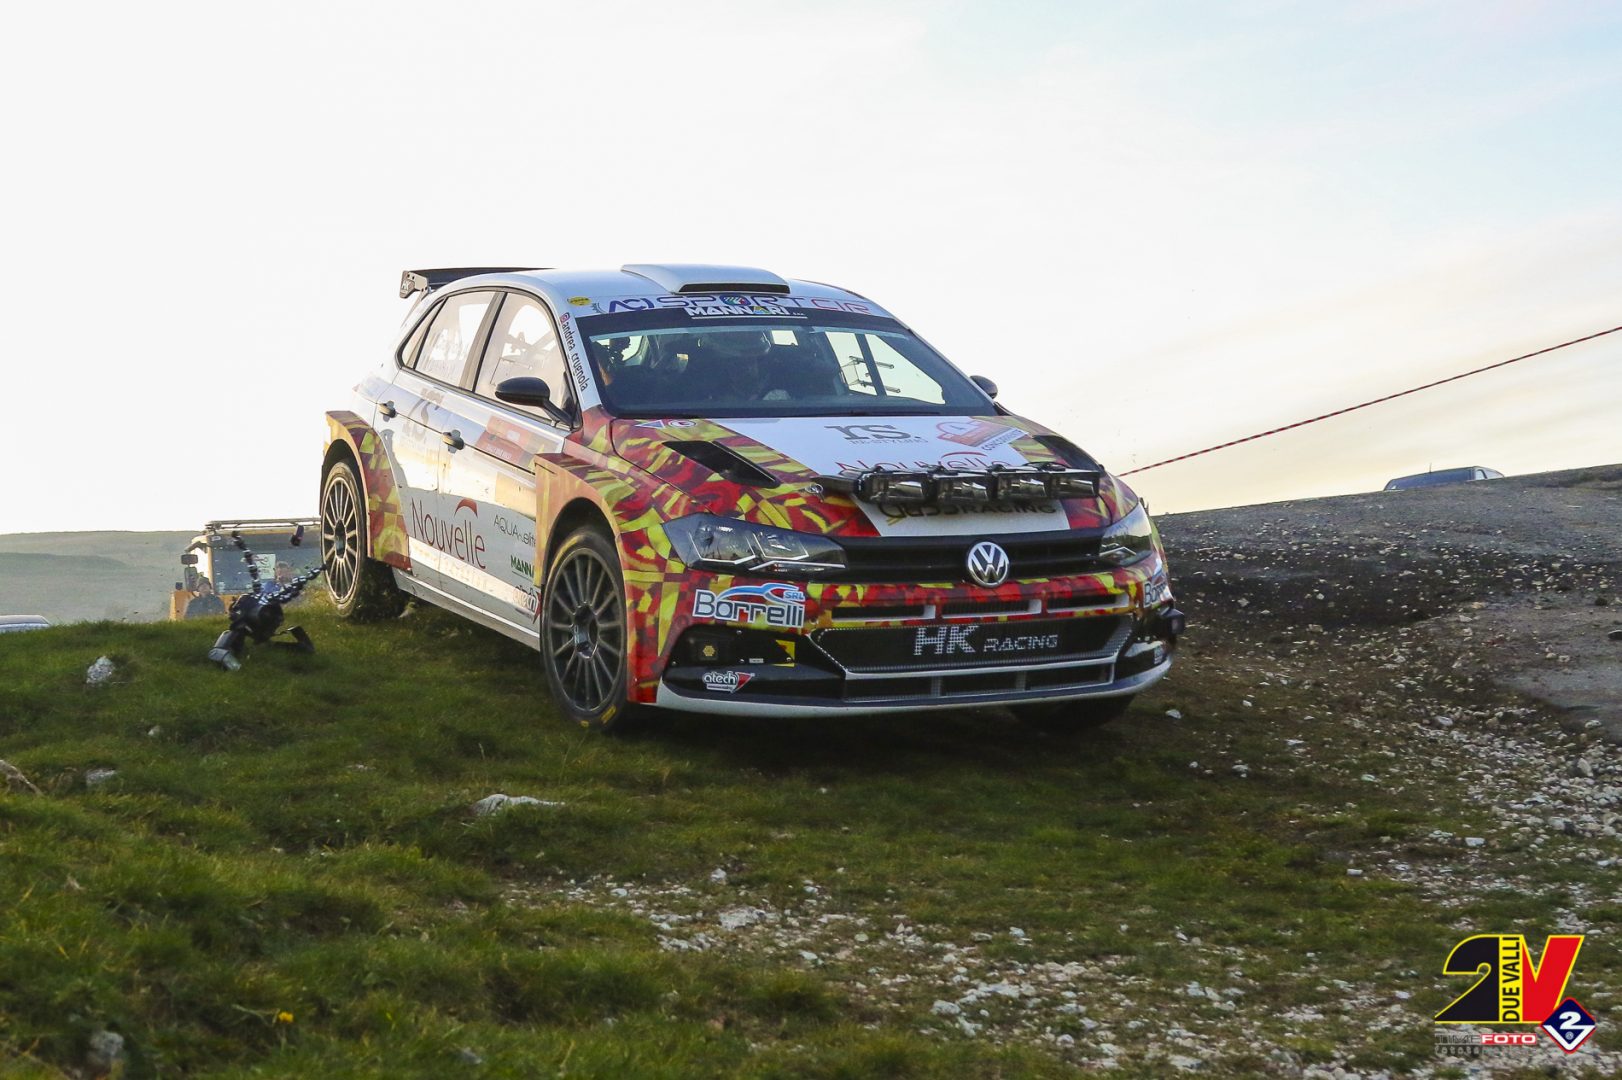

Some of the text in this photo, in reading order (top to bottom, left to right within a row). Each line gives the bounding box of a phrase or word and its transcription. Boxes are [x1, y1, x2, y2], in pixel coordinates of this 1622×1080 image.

[684, 305, 790, 317] MANNARI
[411, 496, 486, 570] Nouvelle
[694, 589, 805, 627] Borrelli
[913, 625, 1059, 656] HK RACING
[703, 671, 739, 685] atech
